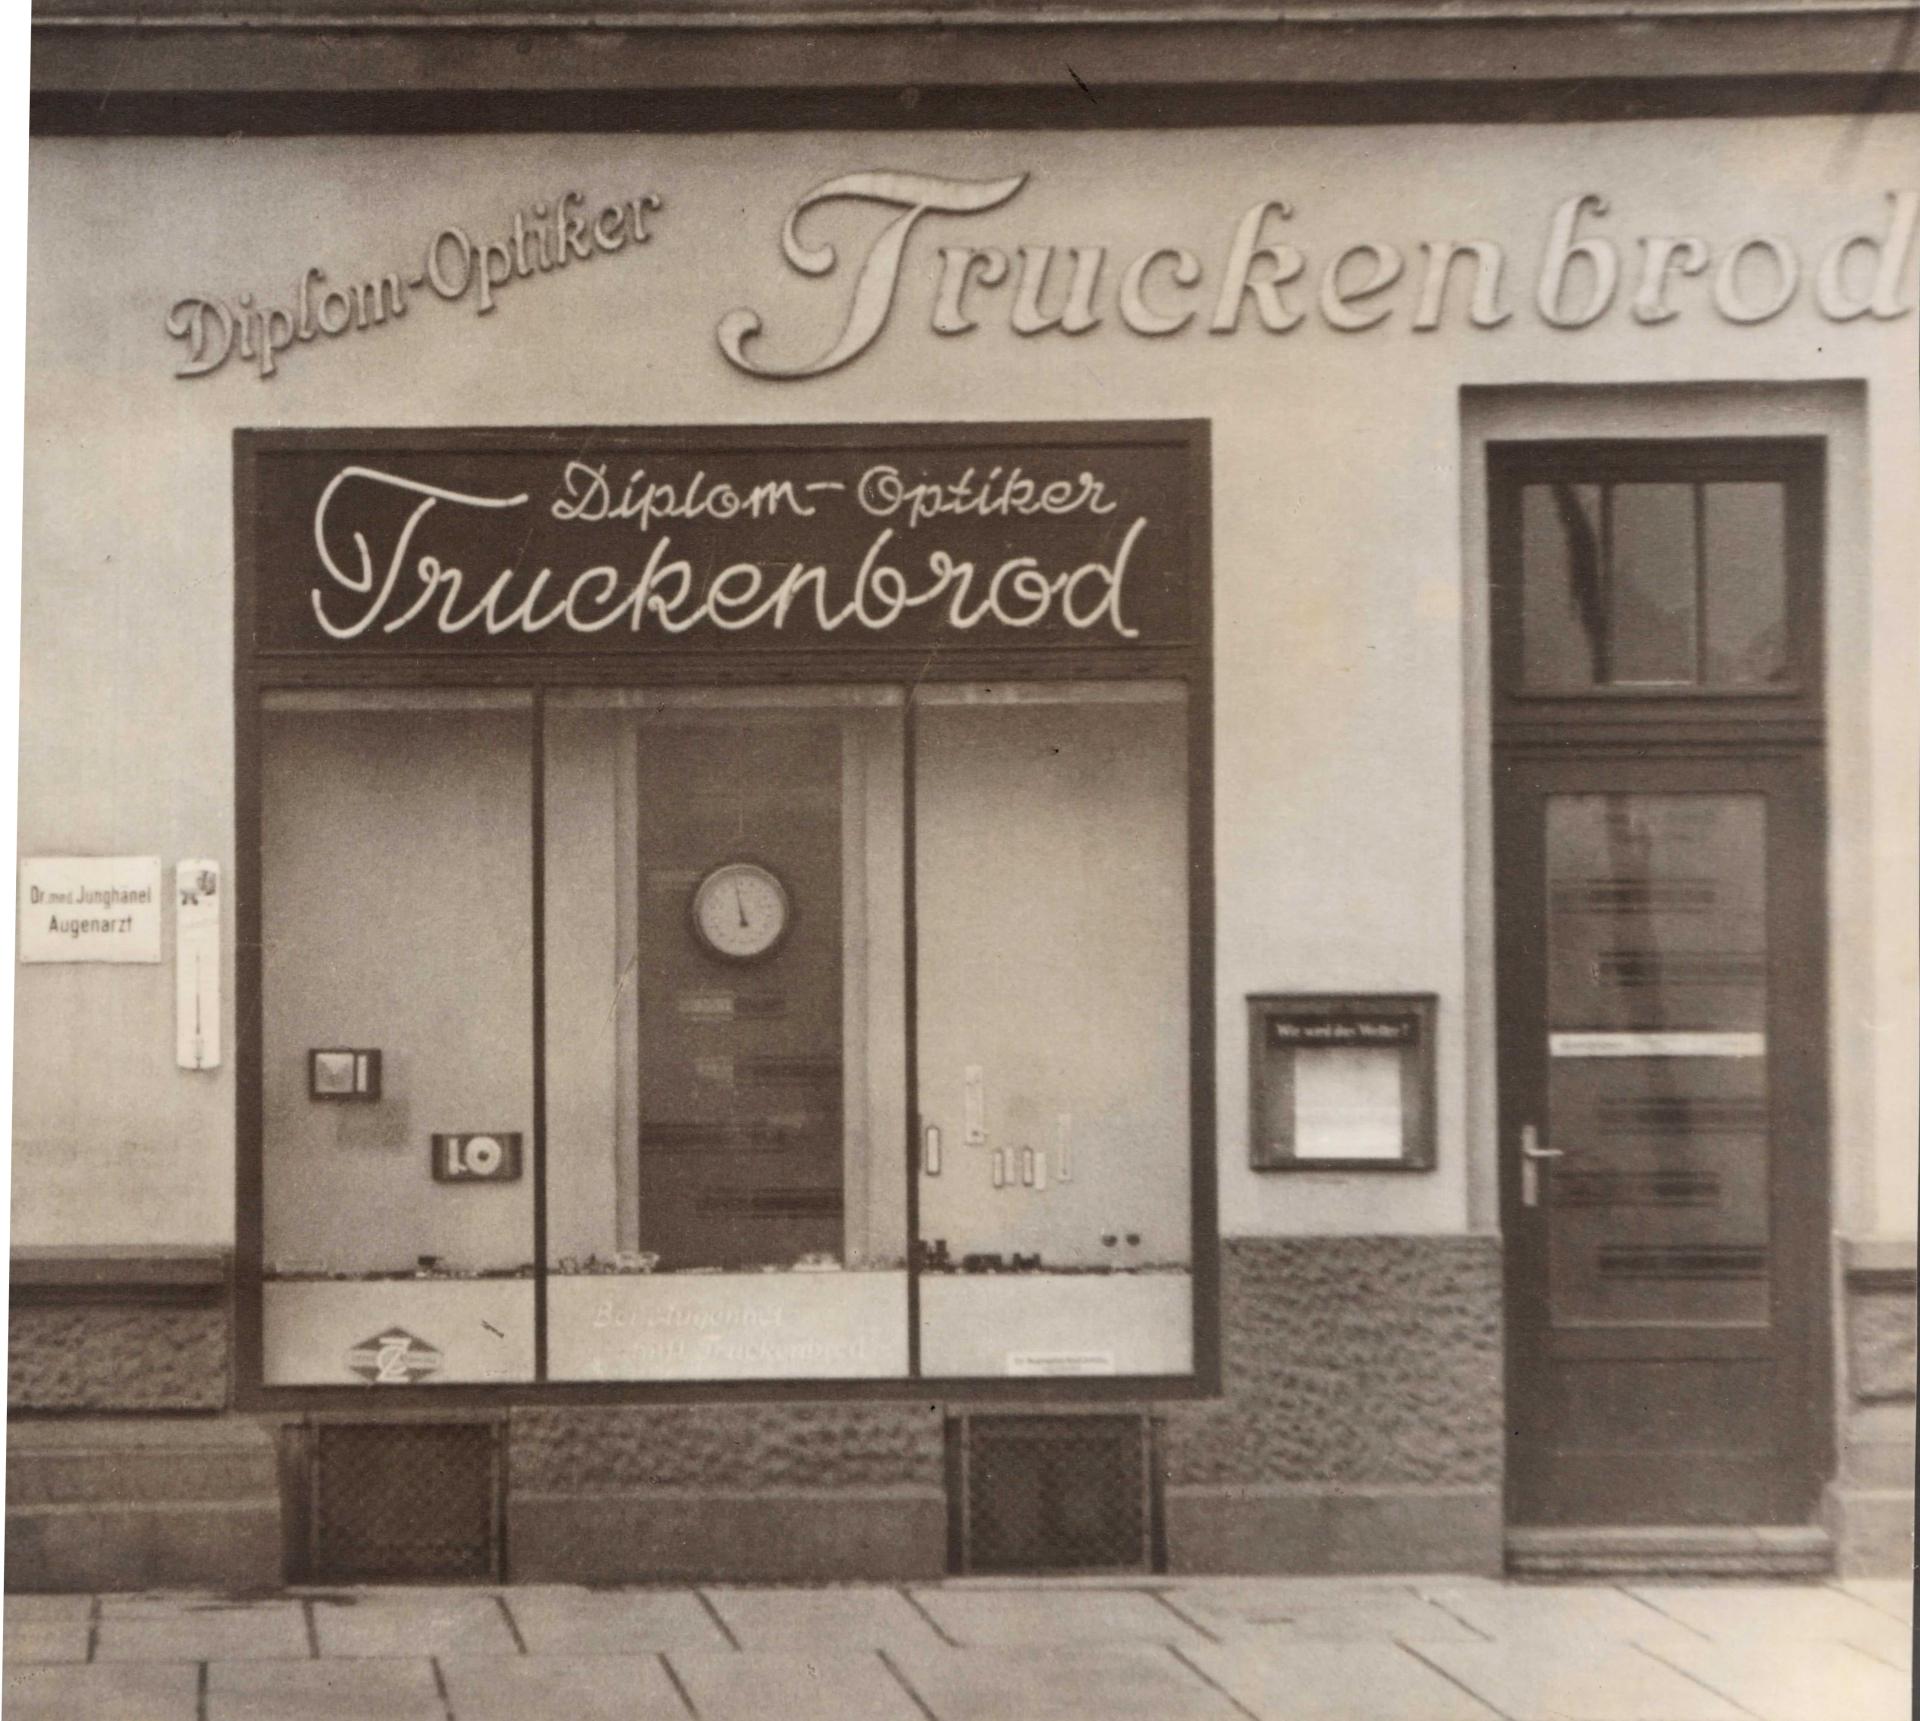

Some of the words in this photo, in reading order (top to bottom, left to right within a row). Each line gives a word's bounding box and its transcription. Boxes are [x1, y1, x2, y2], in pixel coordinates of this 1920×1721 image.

[166, 192, 662, 381] Diplom-Optiker
[716, 169, 1918, 383] Truckenbrod
[311, 465, 1147, 640] Truckenbrod
[49, 914, 132, 938] Augenarzt
